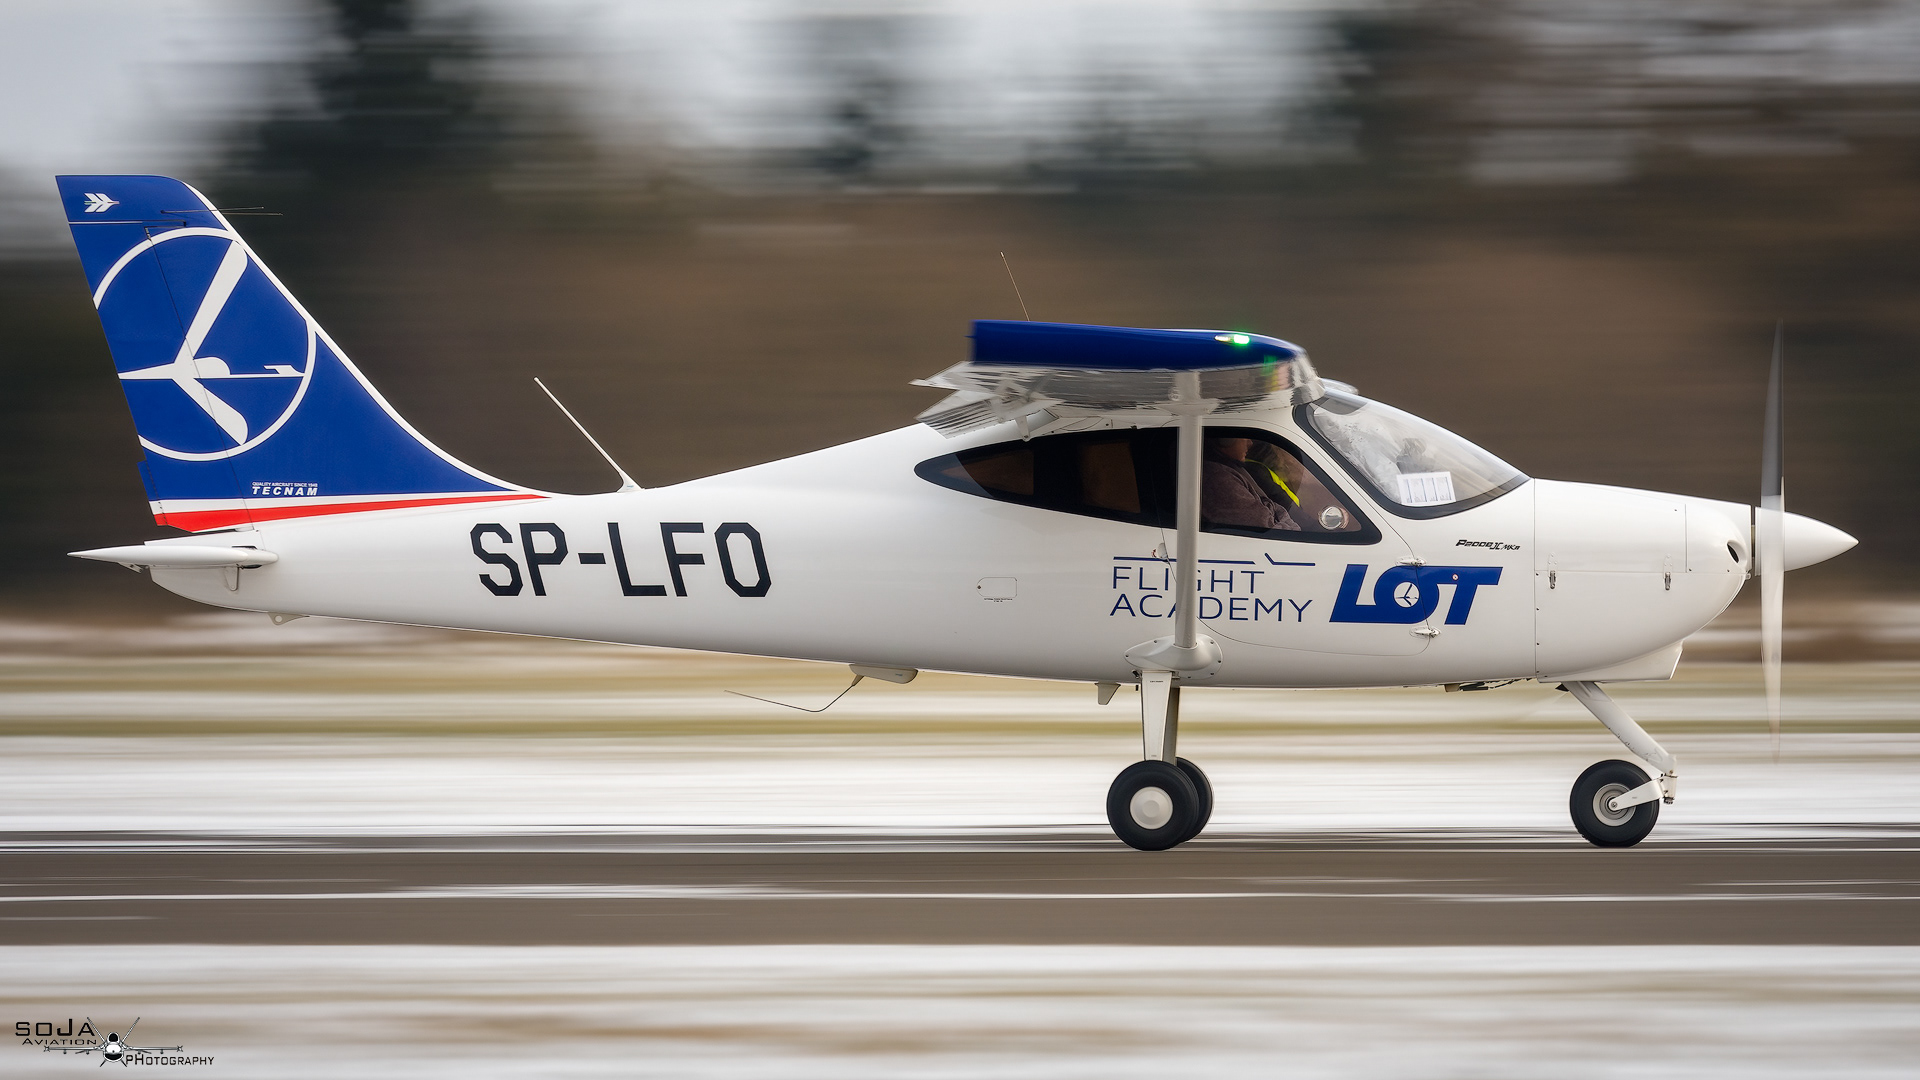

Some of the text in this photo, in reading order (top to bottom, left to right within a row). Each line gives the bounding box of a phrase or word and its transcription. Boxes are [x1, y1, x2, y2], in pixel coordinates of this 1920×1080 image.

[252, 486, 318, 496] TECNAM
[470, 522, 772, 598] SP-LFO
[1112, 566, 1265, 594] FLIHT
[1329, 563, 1503, 625] LOT
